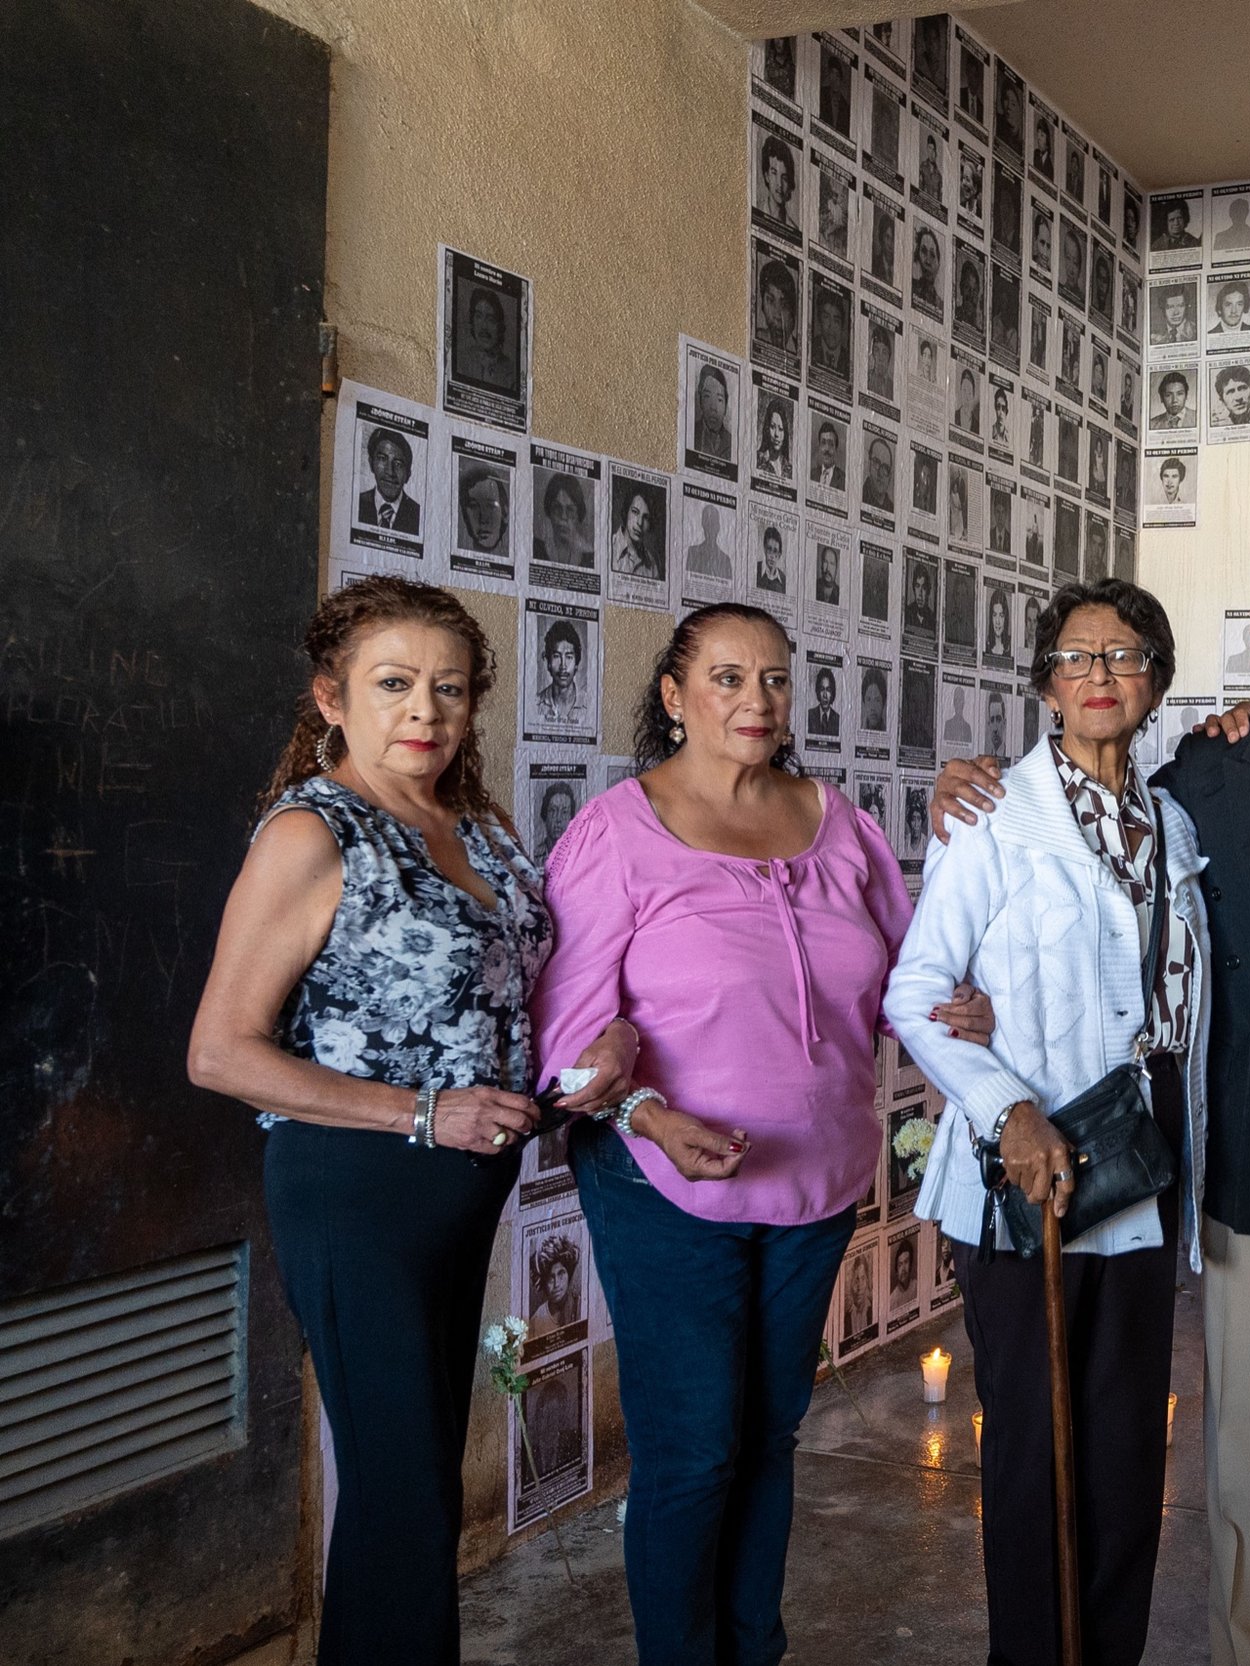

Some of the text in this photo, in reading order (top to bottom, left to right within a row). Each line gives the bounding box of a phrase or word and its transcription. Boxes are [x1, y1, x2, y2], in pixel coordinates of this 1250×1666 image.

[529, 601, 536, 609] NI
[539, 603, 563, 614] OLVIDO,
[565, 607, 573, 615] NI
[526, 1224, 550, 1237] JUSTICIA
